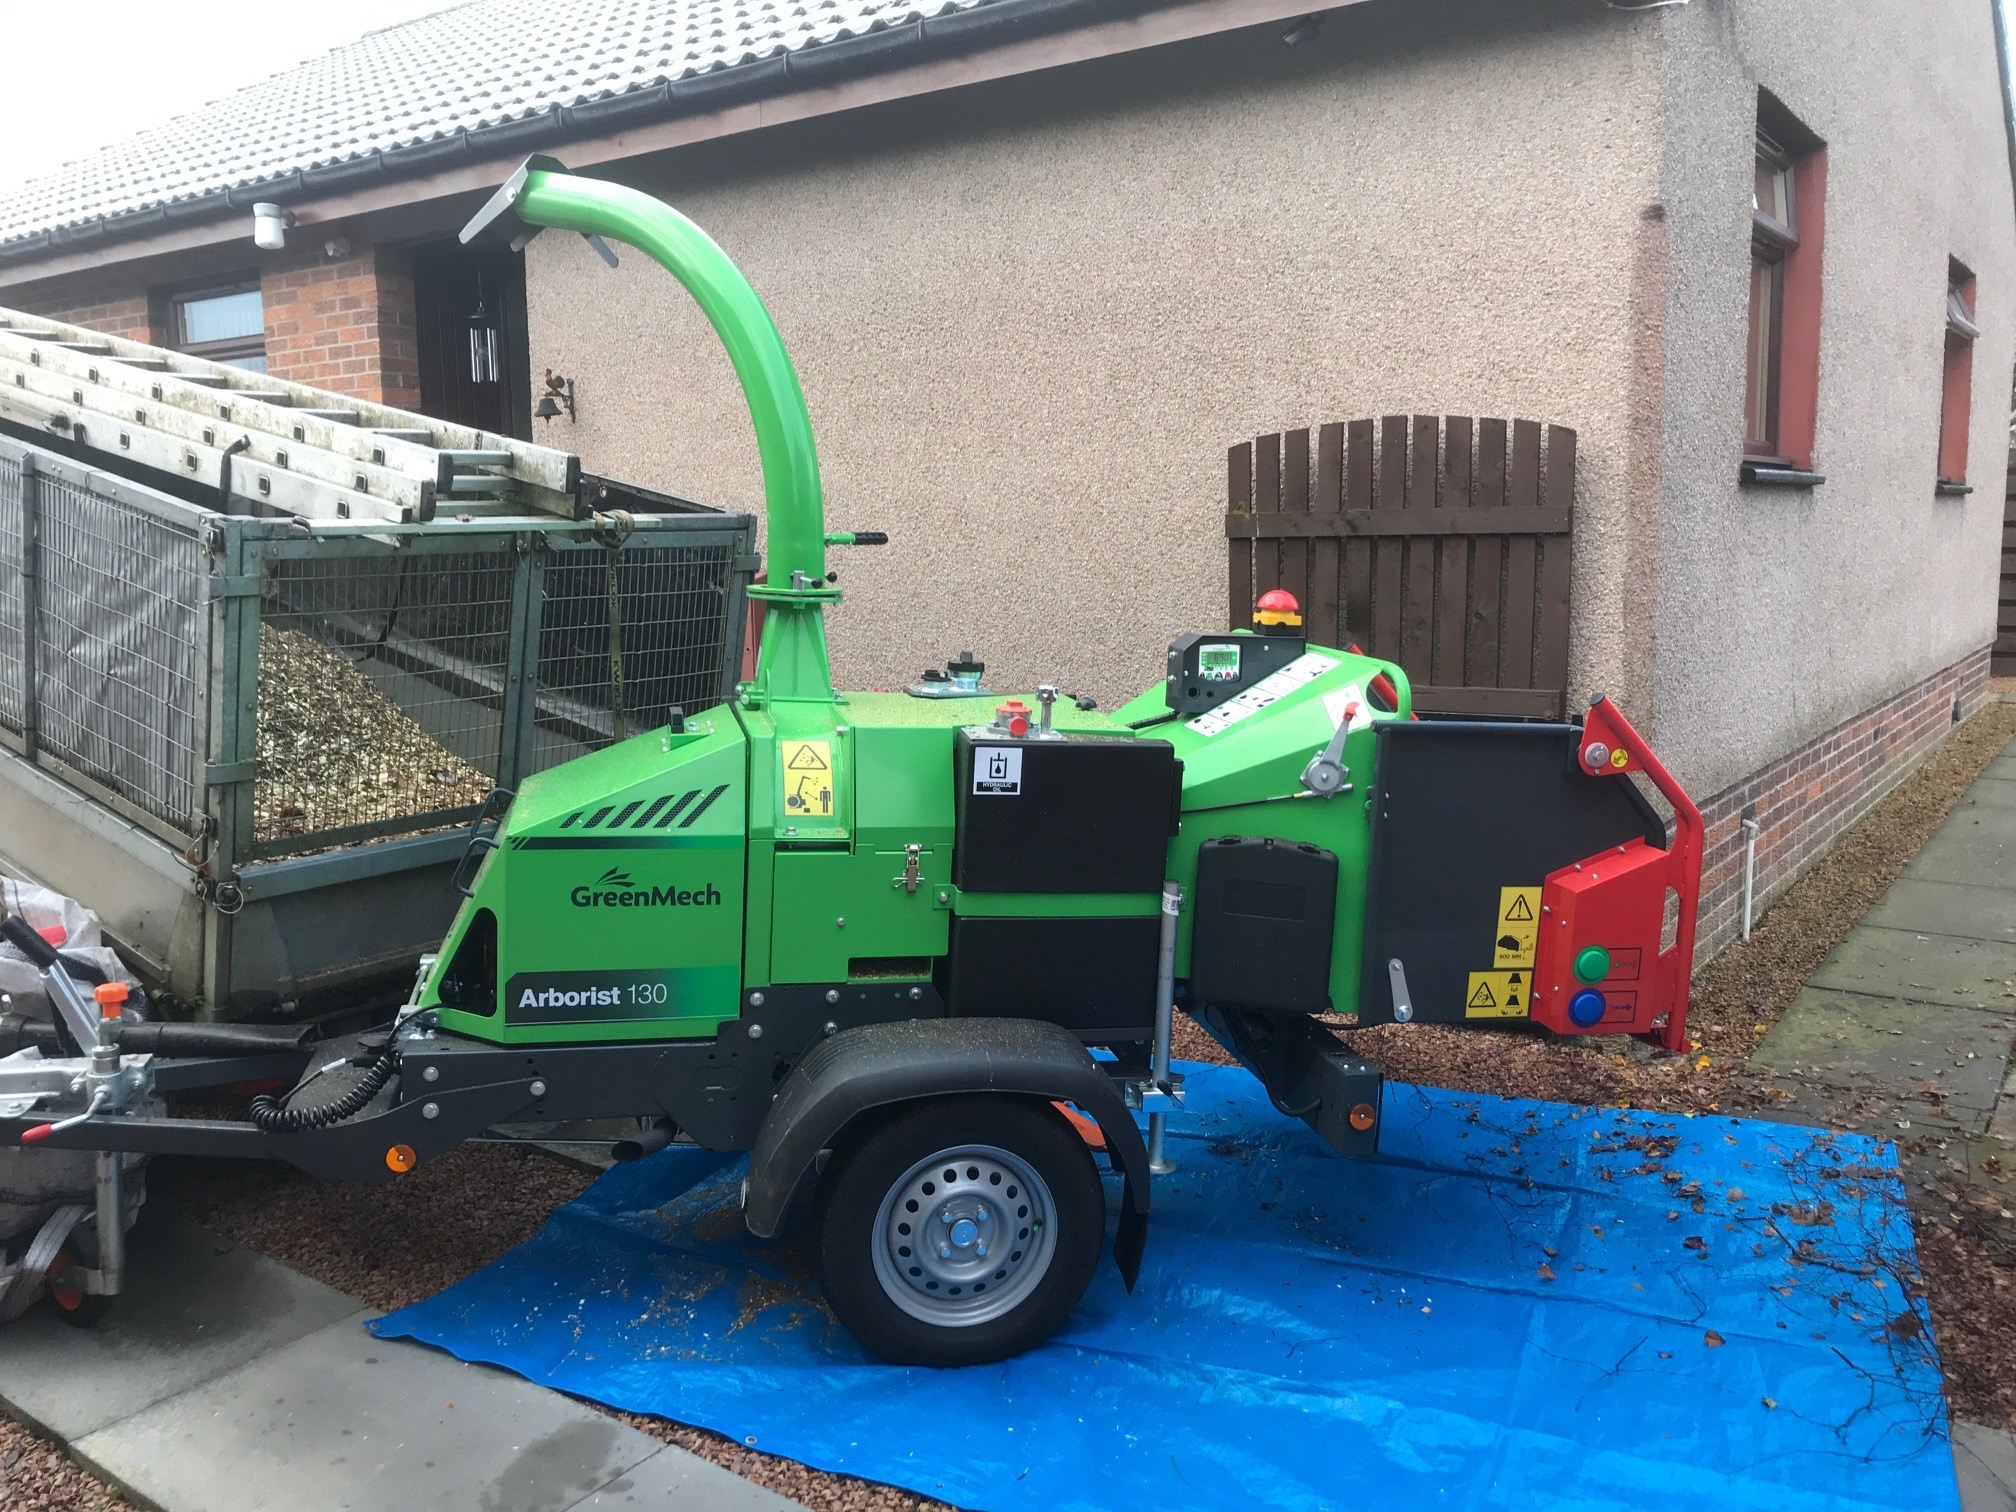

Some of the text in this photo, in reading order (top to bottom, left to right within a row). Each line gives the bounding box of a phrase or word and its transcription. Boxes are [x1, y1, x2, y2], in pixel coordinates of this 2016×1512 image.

[613, 660, 621, 720] KWIKLOK
[571, 883, 721, 907] GreenMech
[518, 983, 668, 1008] Arborist 130
